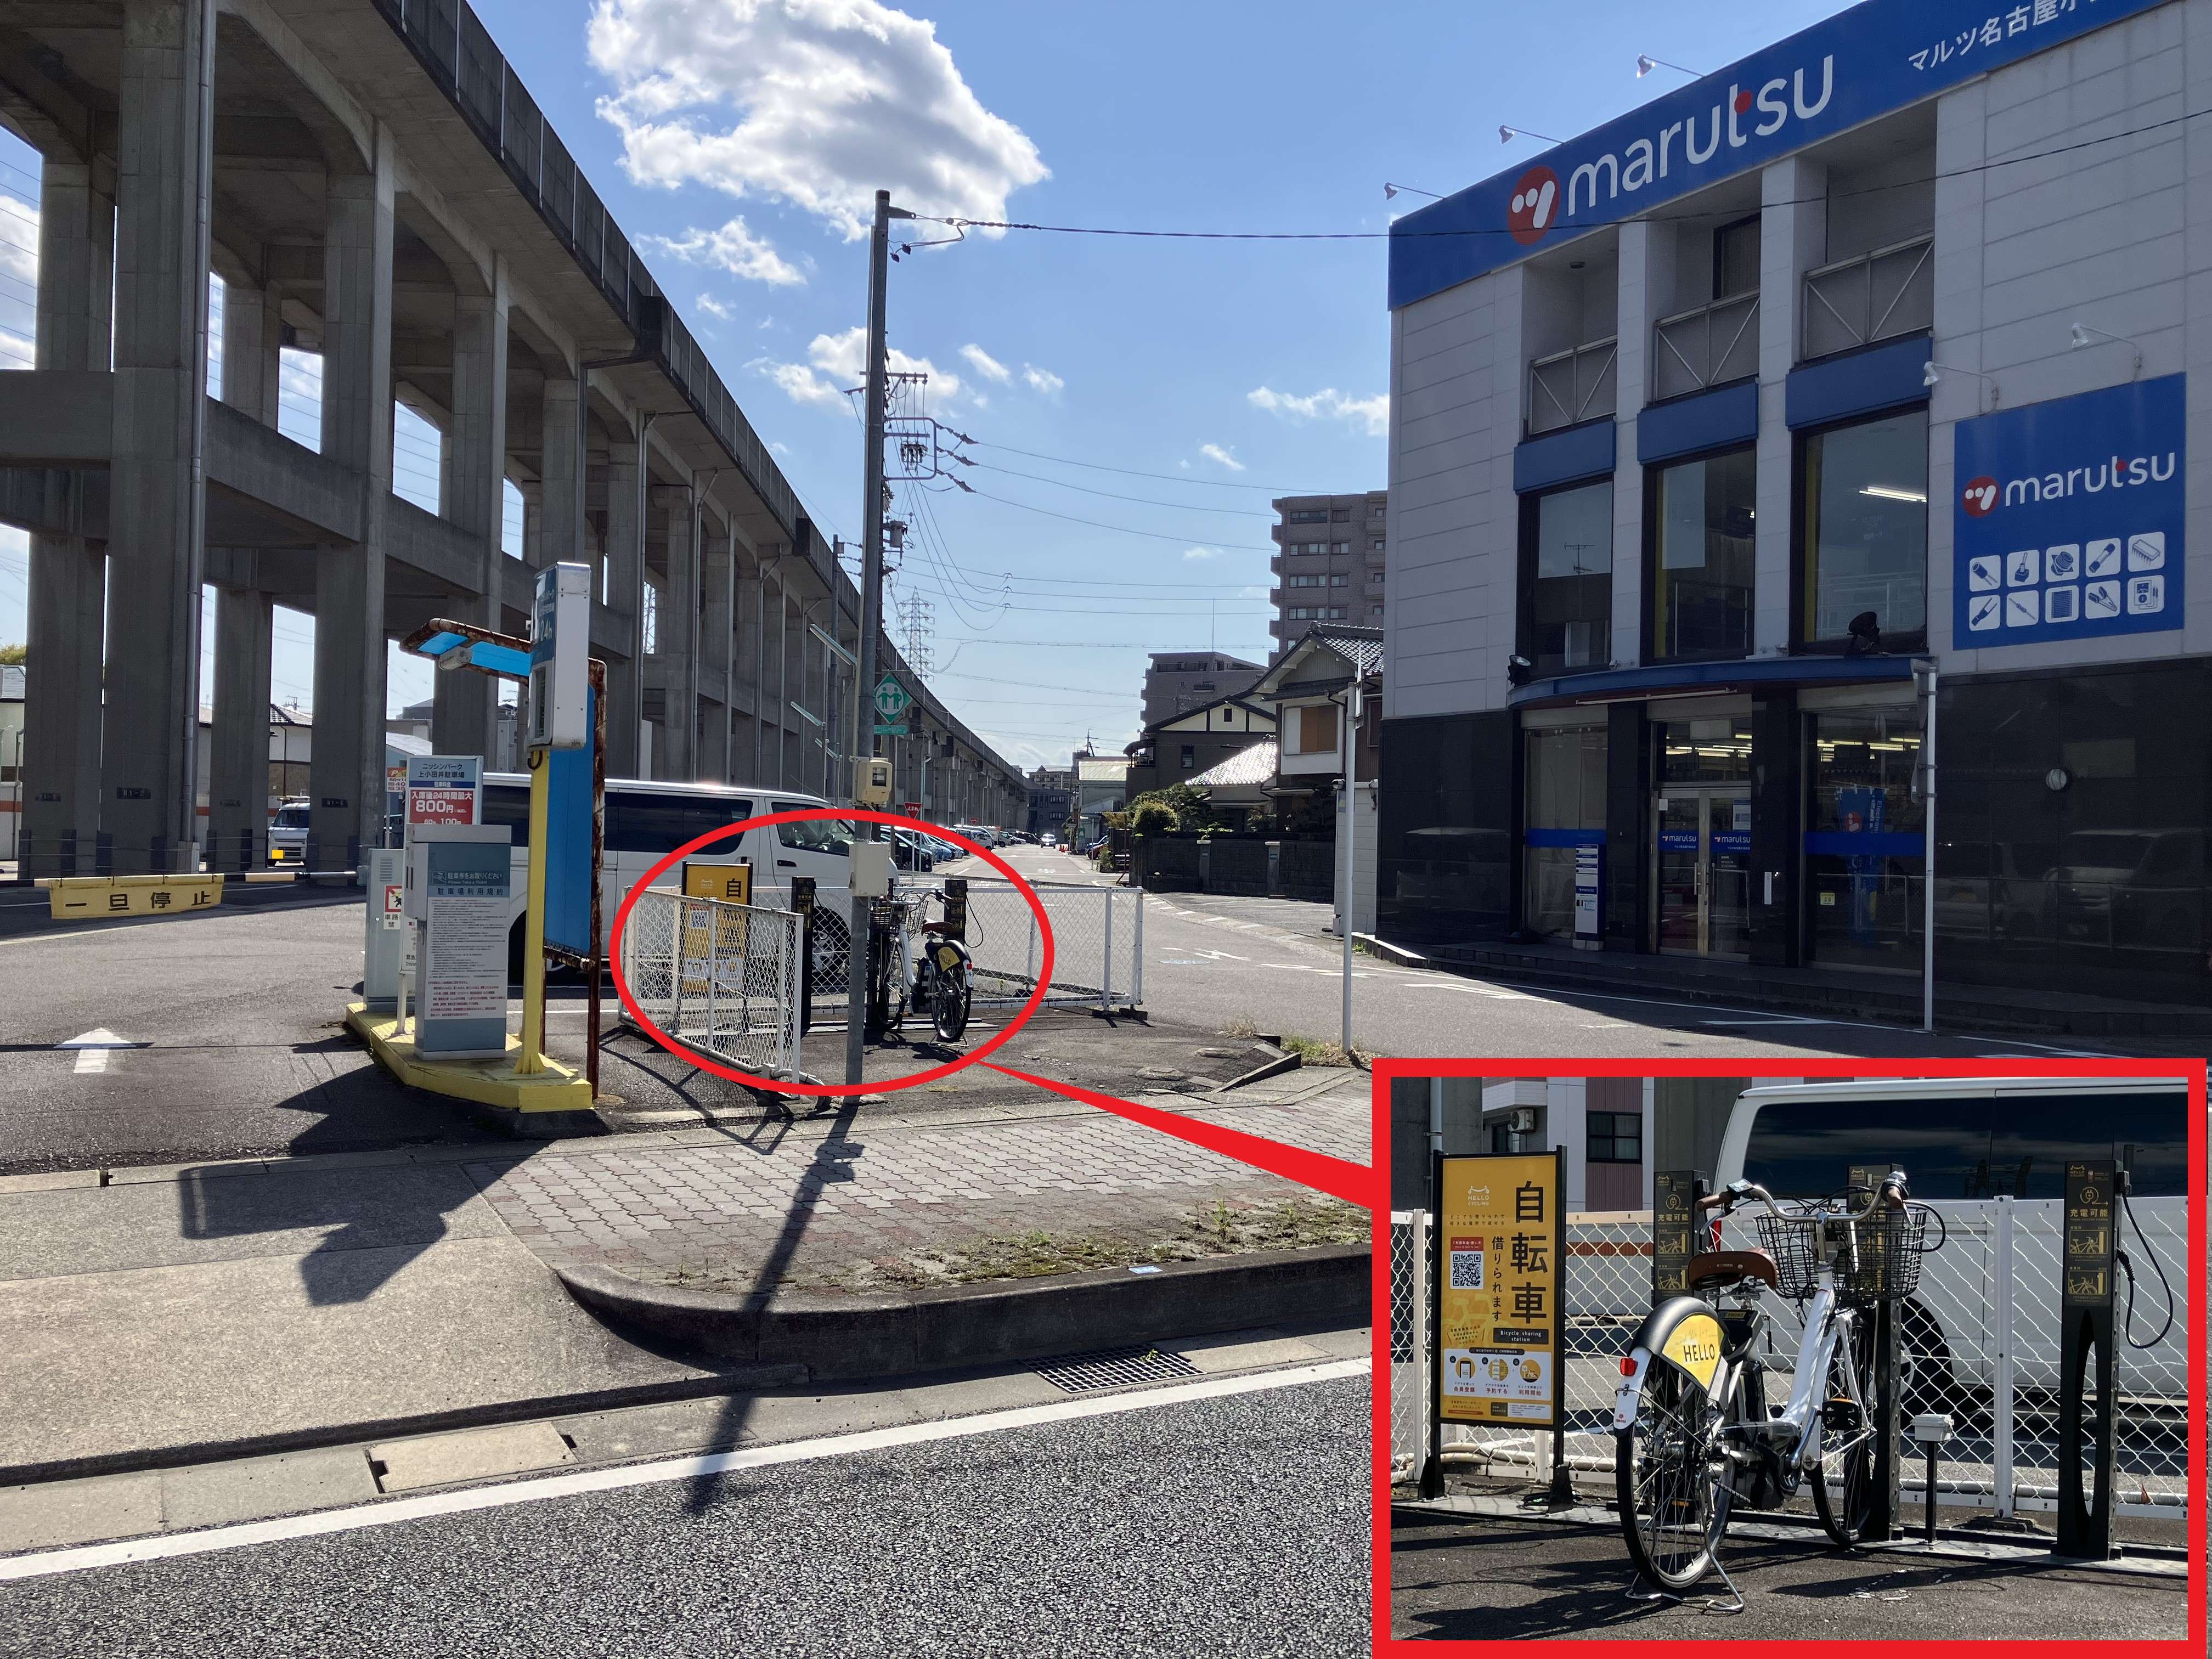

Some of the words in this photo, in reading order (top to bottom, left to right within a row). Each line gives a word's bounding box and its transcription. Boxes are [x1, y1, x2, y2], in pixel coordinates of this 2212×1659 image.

[1567, 55, 1835, 217] marutsu
[2005, 452, 2175, 506] marutsu
[411, 791, 472, 800] 入庫後24時間最大
[416, 799, 454, 814] 800円
[65, 890, 212, 911] 一旦停止
[2069, 1209, 2109, 1217] 充電可能
[1510, 1180, 1548, 1324] 自転車
[1492, 1235, 1505, 1322] 借りられます
[1683, 1343, 1716, 1362] HELLO
